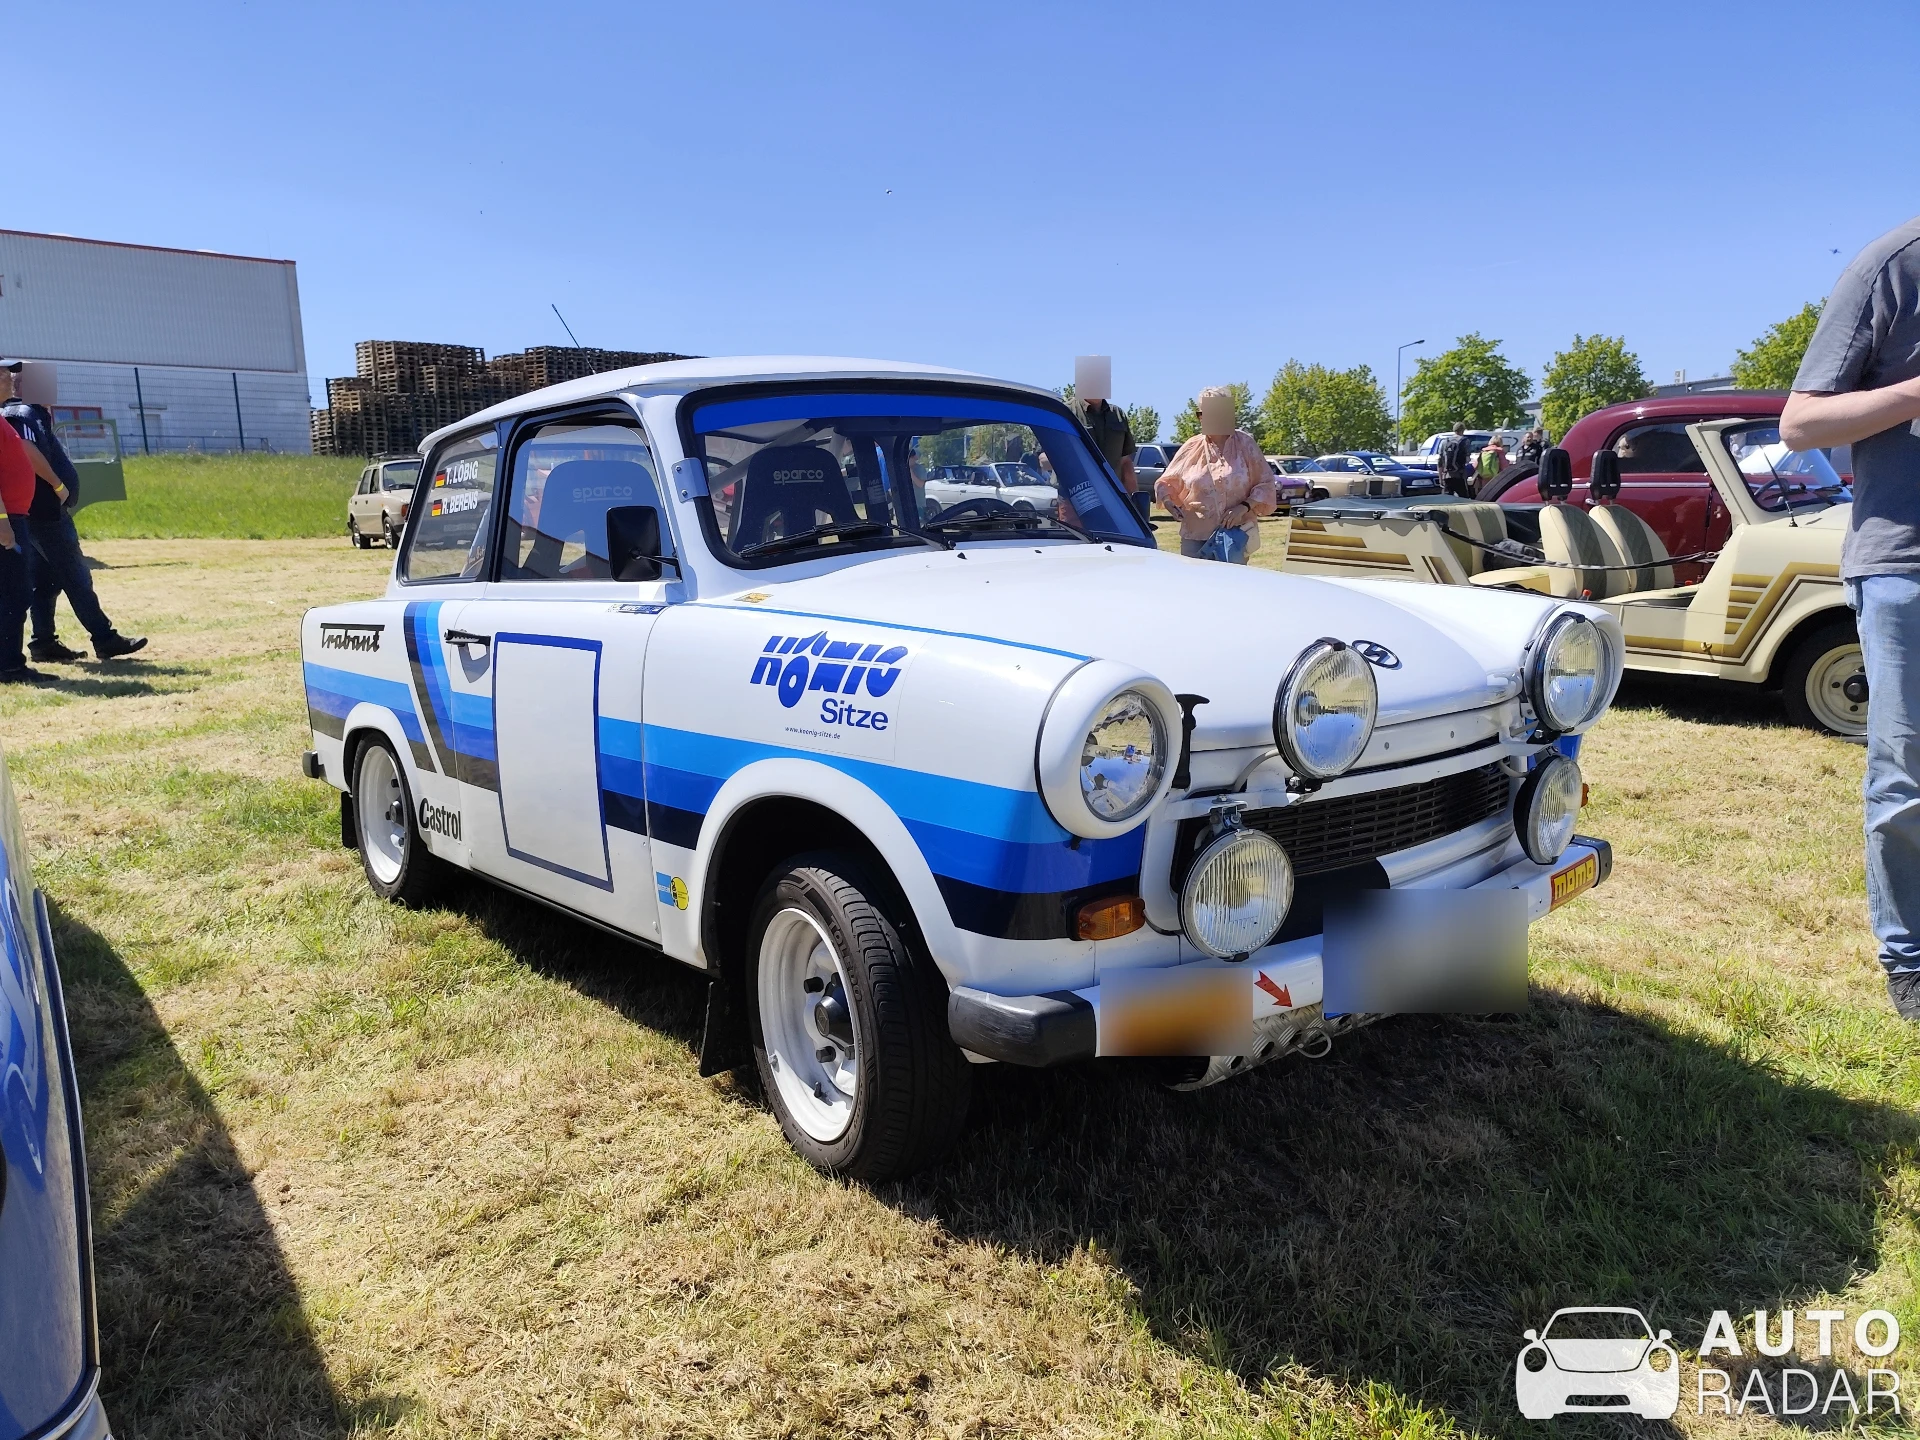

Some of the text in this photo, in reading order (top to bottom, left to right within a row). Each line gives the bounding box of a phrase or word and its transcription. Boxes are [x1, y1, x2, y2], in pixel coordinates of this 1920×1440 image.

[446, 460, 479, 485] T. LÖBIG
[773, 469, 825, 485] sparco
[441, 491, 479, 515] R. BERENS
[573, 486, 633, 503] sparco
[320, 623, 385, 652] Trabant
[820, 698, 889, 731] Sitze
[785, 726, 841, 740] www.koenig-sitze.de
[419, 797, 462, 841] Castrol
